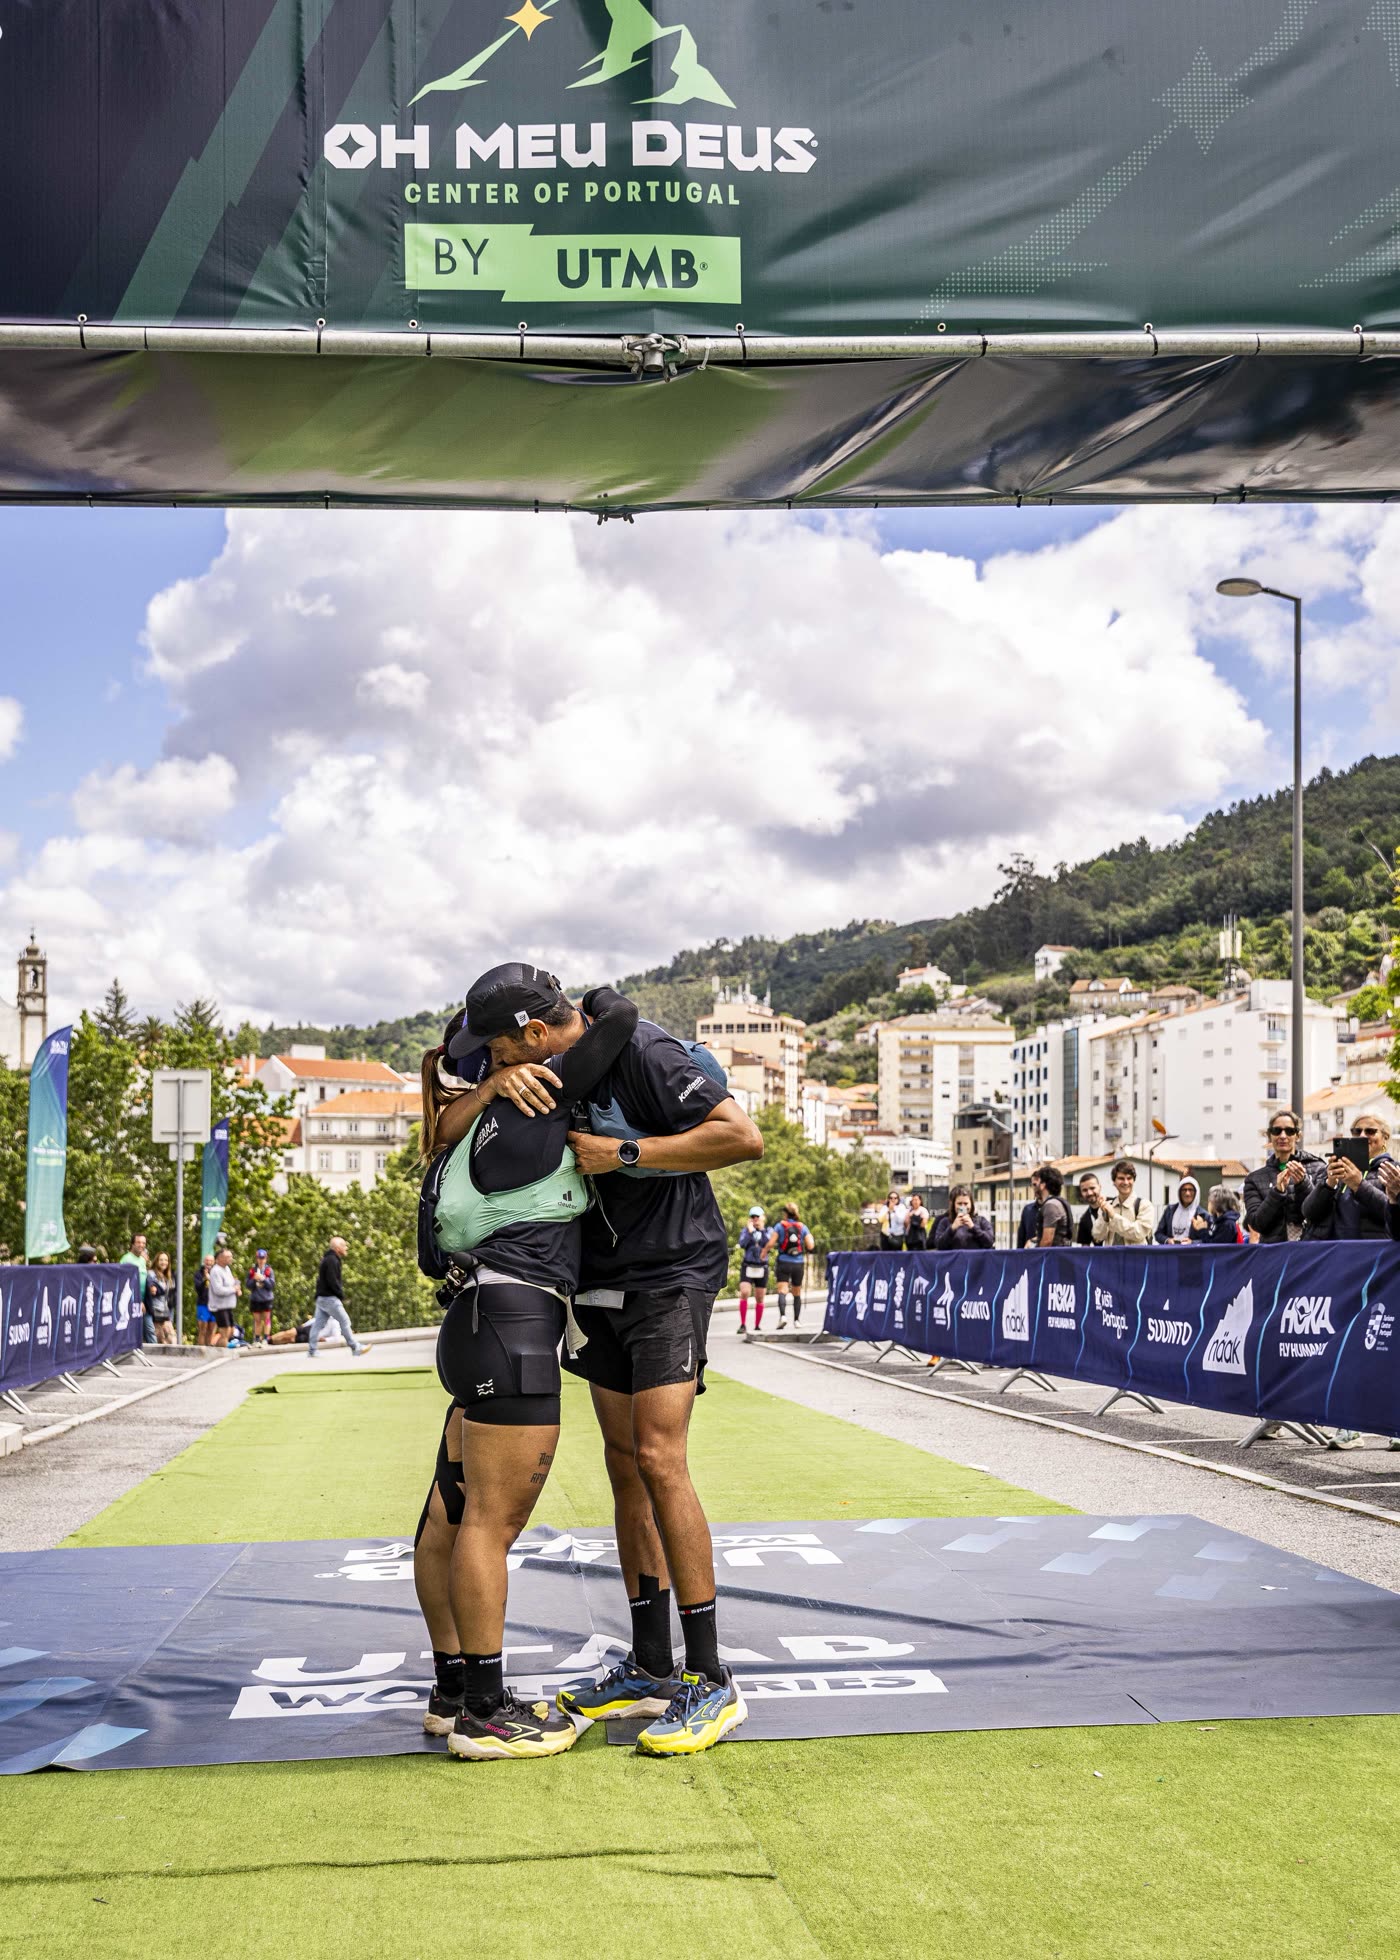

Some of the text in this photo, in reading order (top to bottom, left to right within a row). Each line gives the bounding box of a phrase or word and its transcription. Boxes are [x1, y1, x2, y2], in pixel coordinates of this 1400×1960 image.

[324, 121, 818, 173] OH MEU DEUS
[404, 181, 740, 205] CENTER OF PORTUGAL
[434, 238, 490, 275] BY
[678, 1076, 704, 1102] Kailash
[1048, 1283, 1076, 1313] HOKA
[1279, 1296, 1336, 1334] HOKA
[1147, 1317, 1193, 1346] SUUNTO
[1208, 1331, 1240, 1365] näak
[1279, 1342, 1290, 1358] FLY
[484, 1722, 512, 1738] BROOKS
